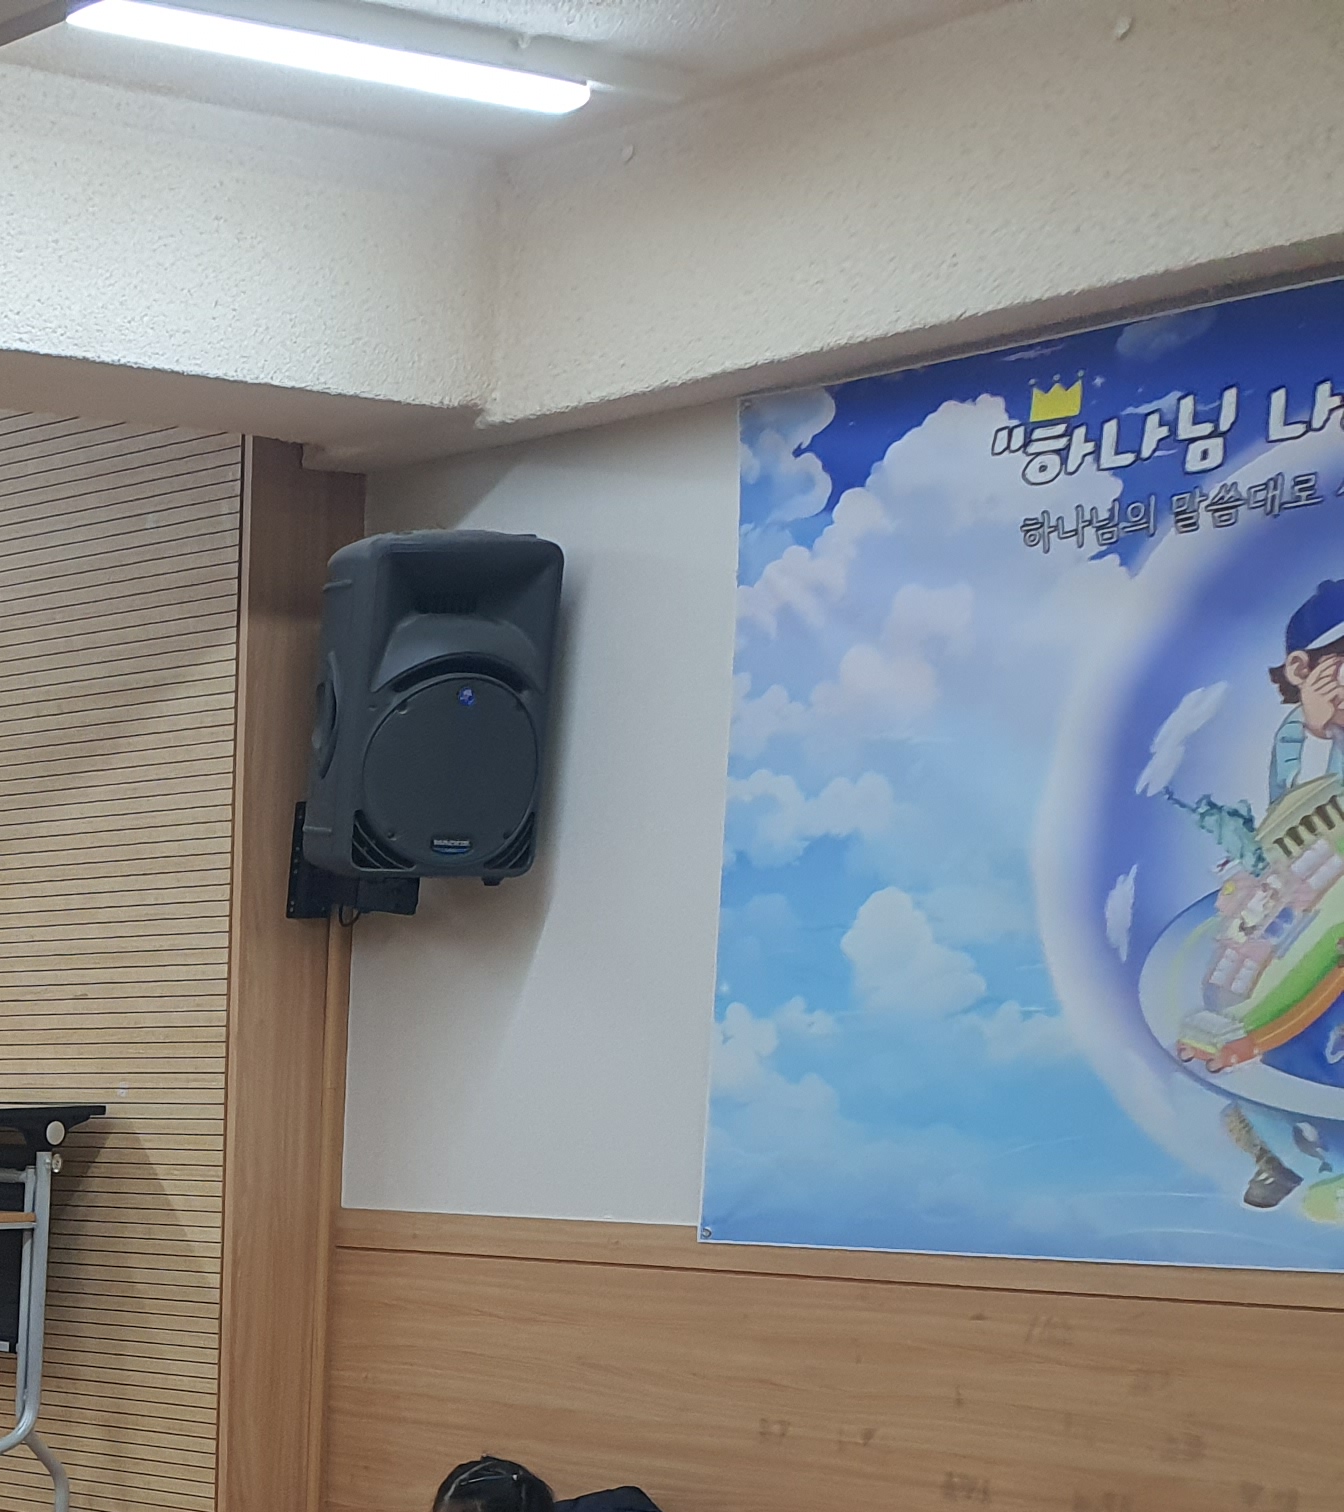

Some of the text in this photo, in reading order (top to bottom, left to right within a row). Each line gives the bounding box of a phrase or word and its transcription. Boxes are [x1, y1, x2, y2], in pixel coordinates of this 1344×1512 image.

[992, 386, 1239, 486] "하나님
[1020, 472, 1323, 554] 하나님의 말씀대로
